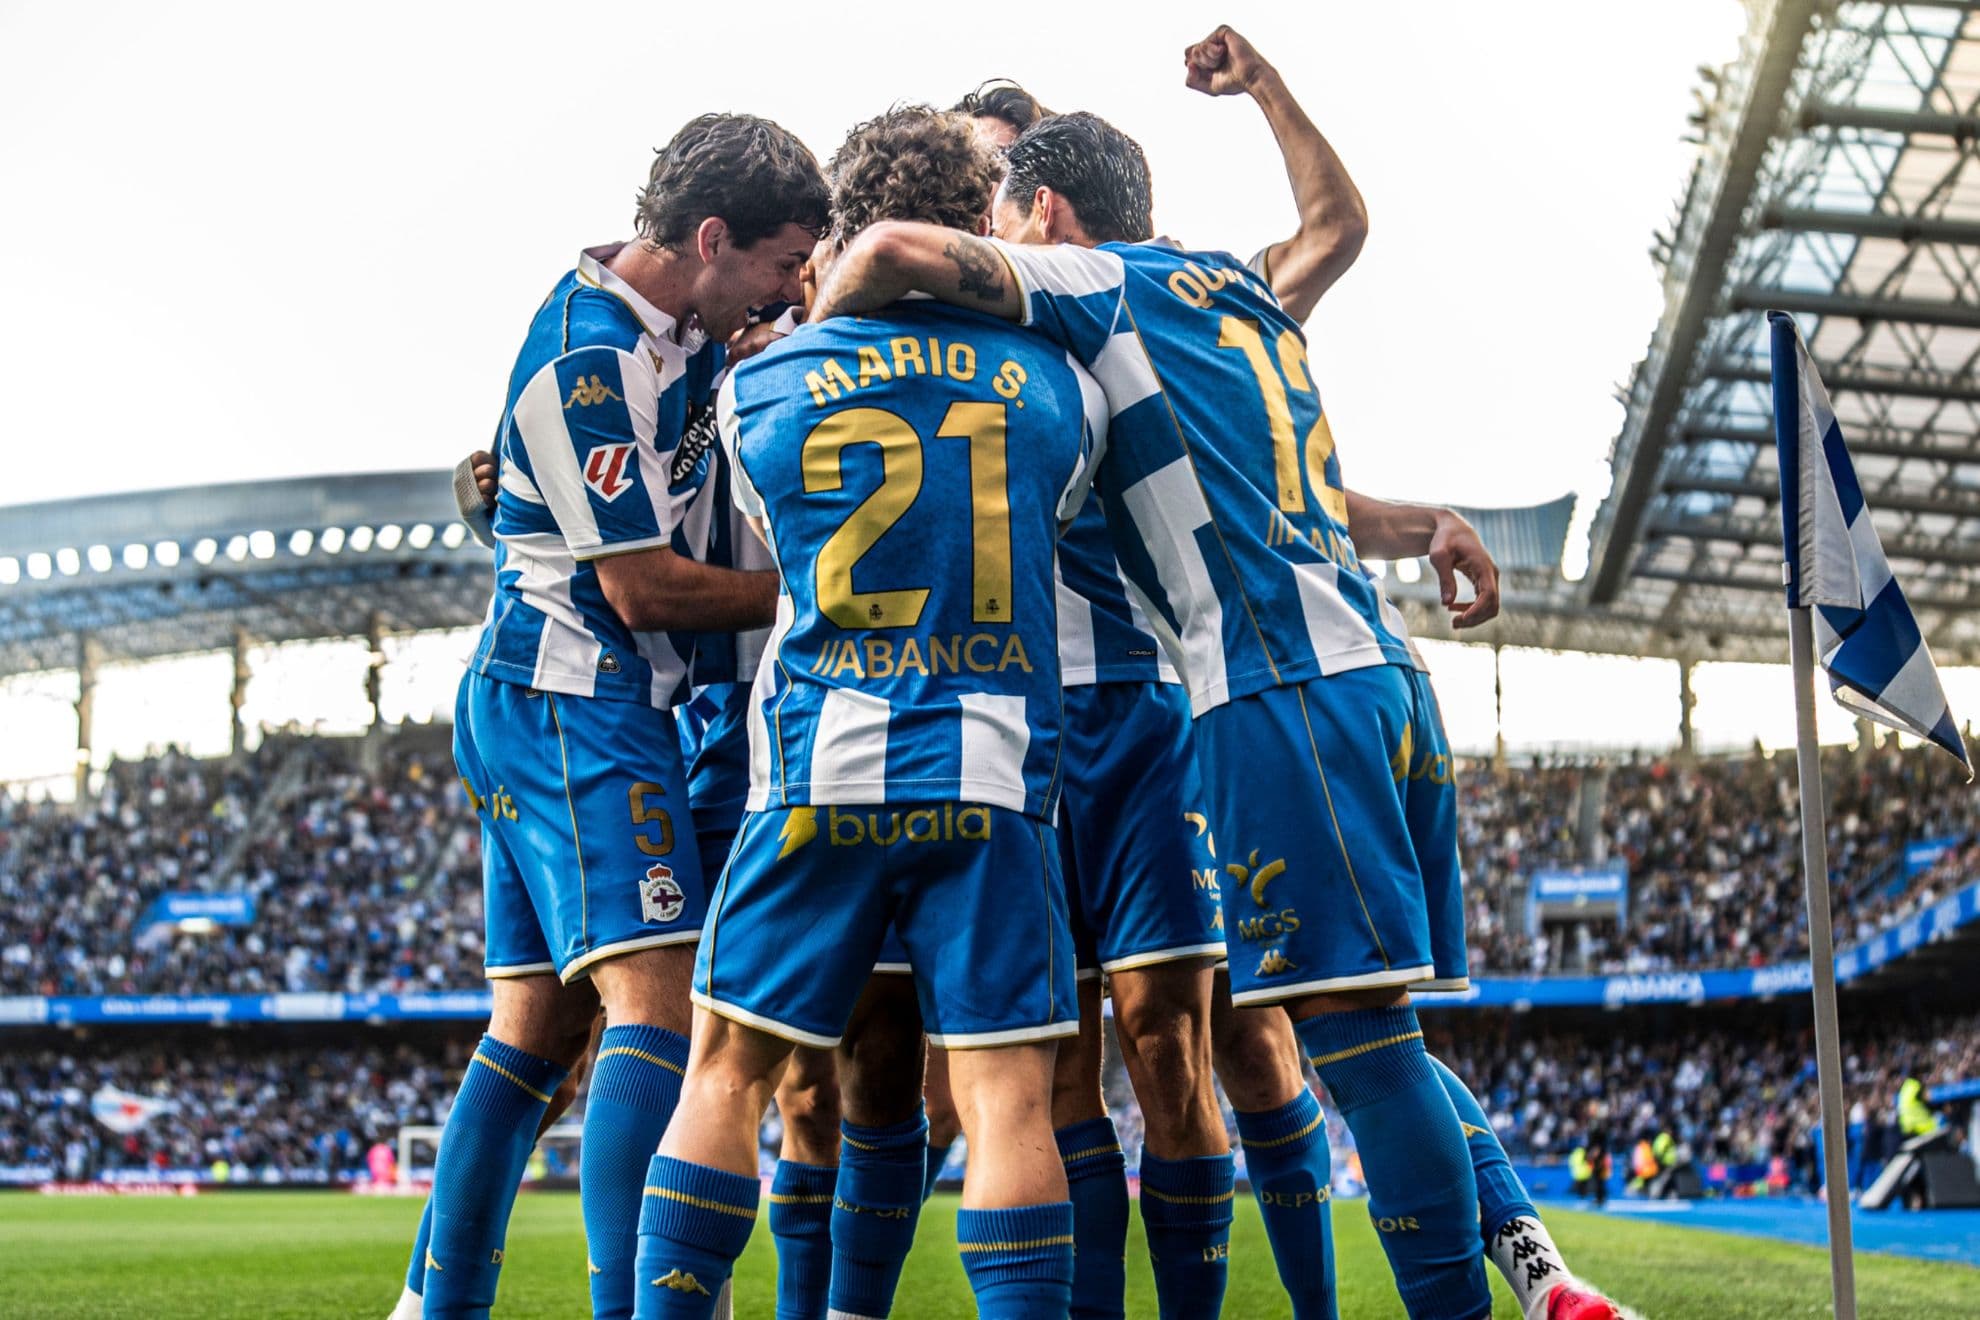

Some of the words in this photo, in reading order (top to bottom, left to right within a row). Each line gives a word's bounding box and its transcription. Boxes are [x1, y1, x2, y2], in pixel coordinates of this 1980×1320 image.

[803, 335, 977, 409] MARIO
[991, 359, 1029, 410] S.
[801, 400, 1013, 631] 21
[628, 781, 675, 856] 5
[828, 802, 992, 847] buala
[1238, 908, 1301, 941] MGS
